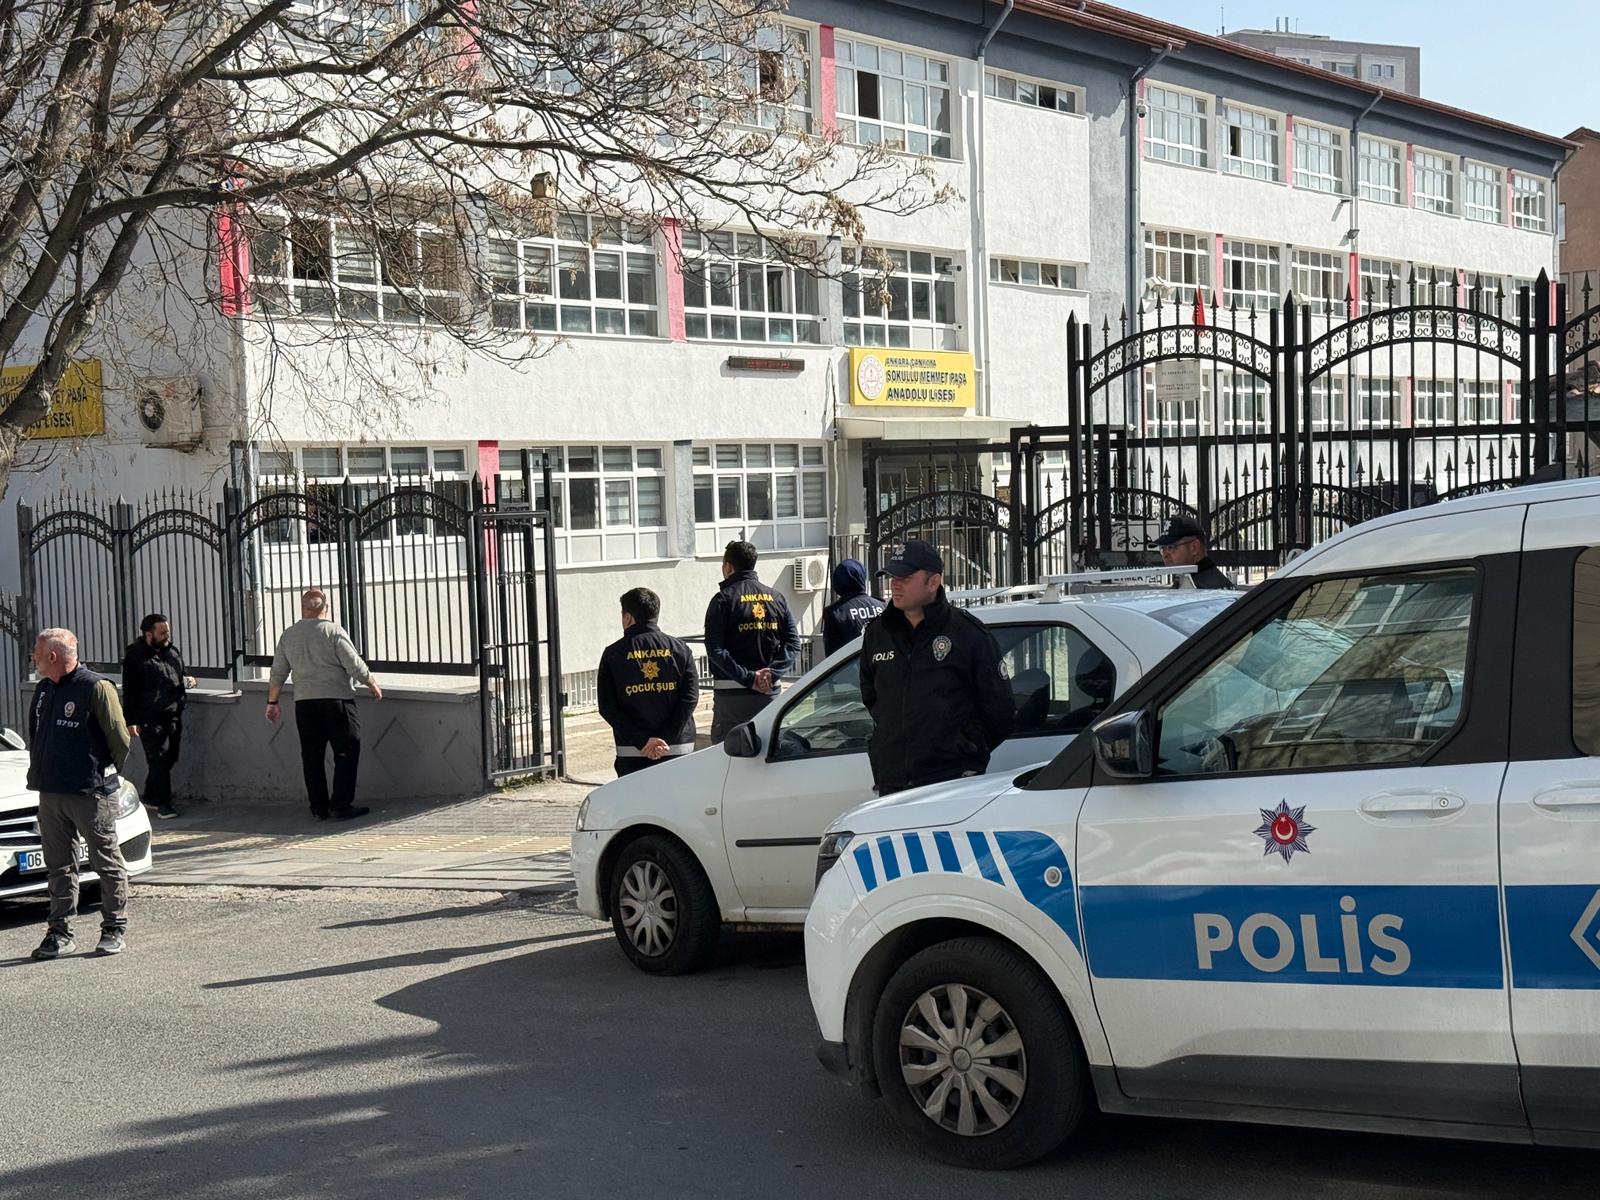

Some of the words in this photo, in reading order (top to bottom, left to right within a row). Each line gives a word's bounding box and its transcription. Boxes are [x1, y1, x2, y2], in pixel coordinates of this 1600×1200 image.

[885, 357, 909, 367] ANKARA
[886, 369, 919, 383] SOKULLU
[920, 371, 949, 385] MEHMET
[949, 372, 967, 388] PAŞA
[887, 387, 928, 401] ANADOLU
[929, 388, 956, 402] LİSESİ
[740, 593, 774, 603] ANKARA
[850, 605, 883, 620] POLİS
[626, 648, 672, 660] ANKARA
[56, 719, 80, 728] 9797
[27, 852, 42, 868] 06
[1193, 895, 1412, 976] POLİS
